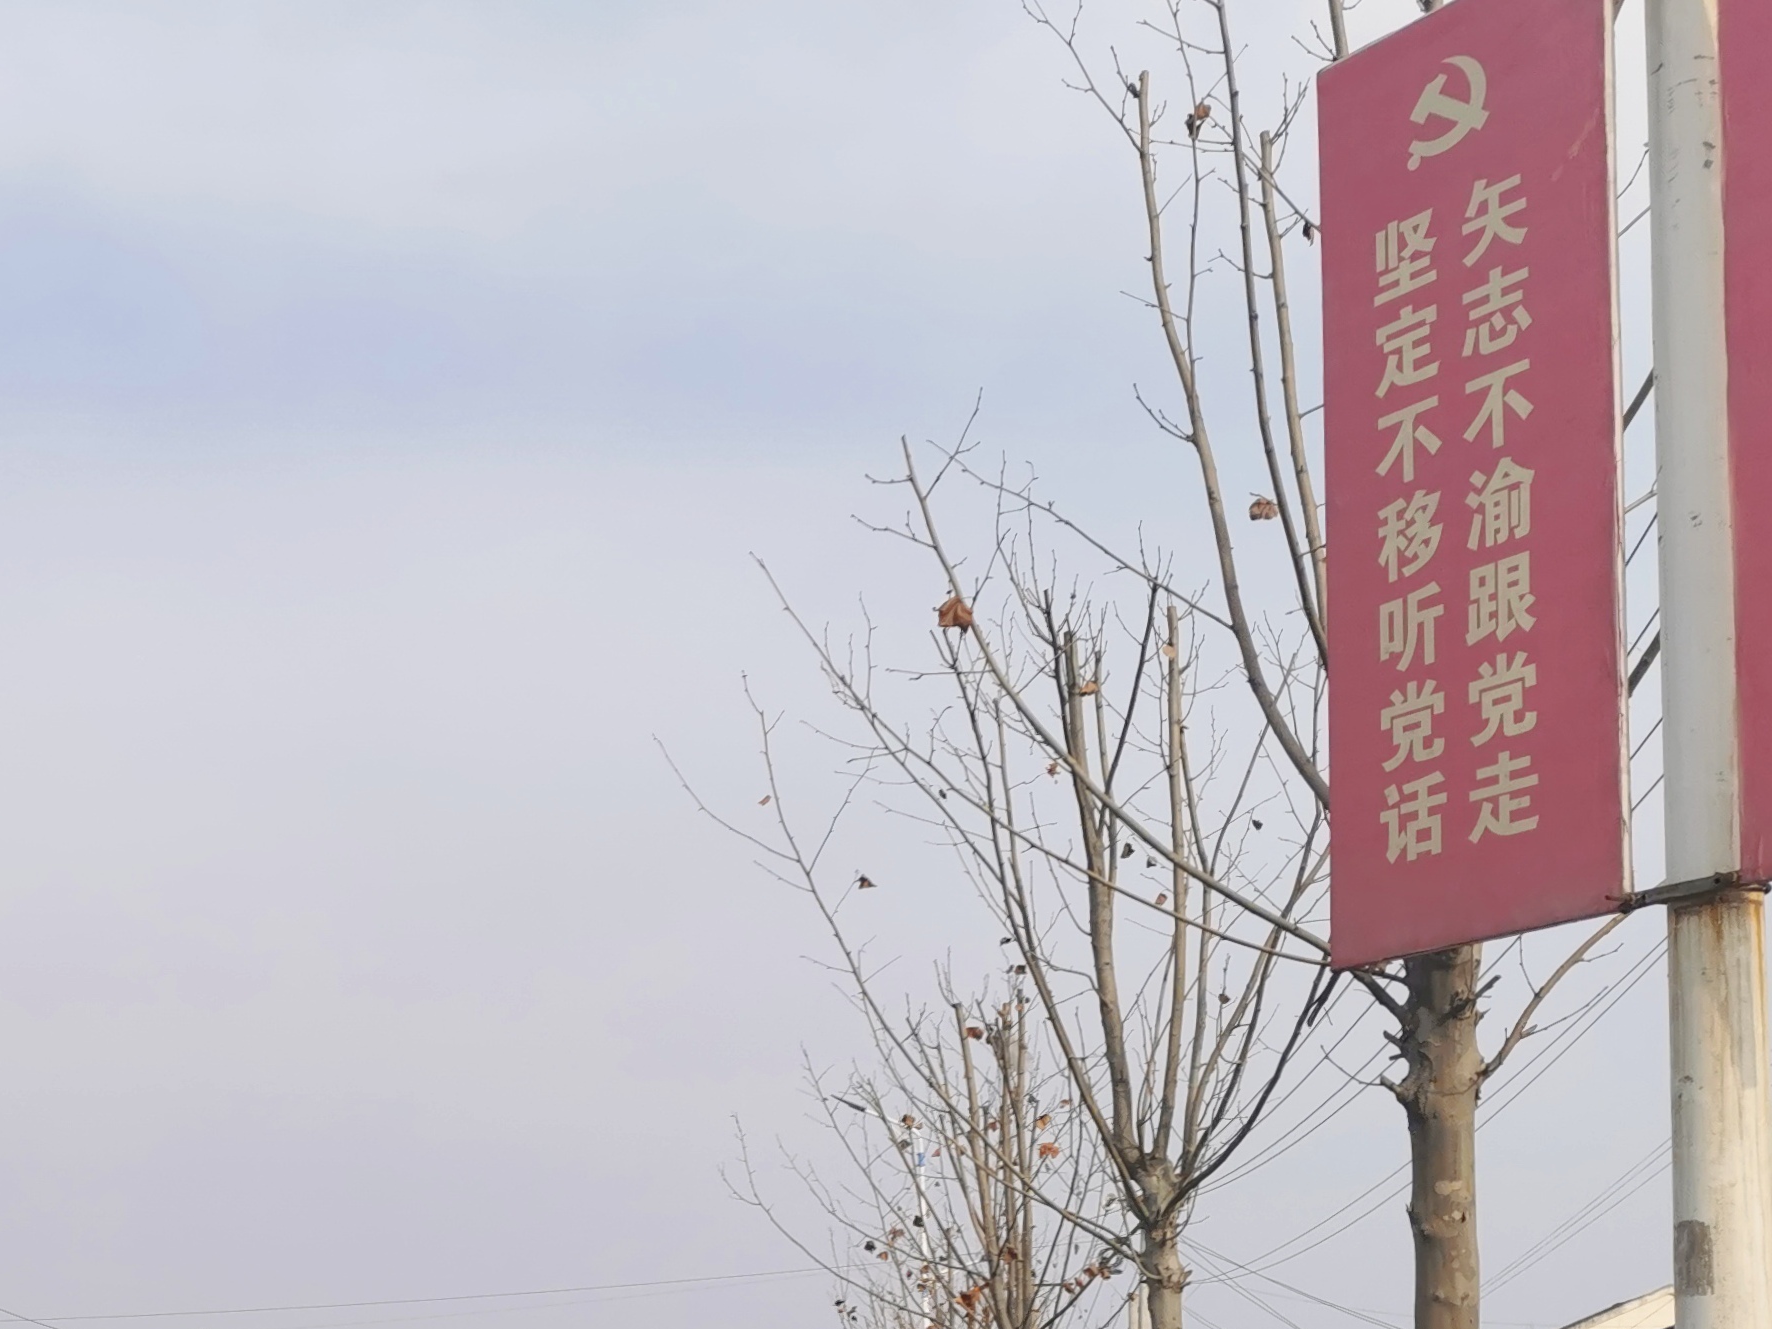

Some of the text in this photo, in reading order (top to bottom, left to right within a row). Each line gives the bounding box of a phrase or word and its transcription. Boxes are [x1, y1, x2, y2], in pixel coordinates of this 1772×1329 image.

[1372, 208, 1448, 865] 坚定不移听党话
[1460, 173, 1539, 845] 矢志不渝跟党走
